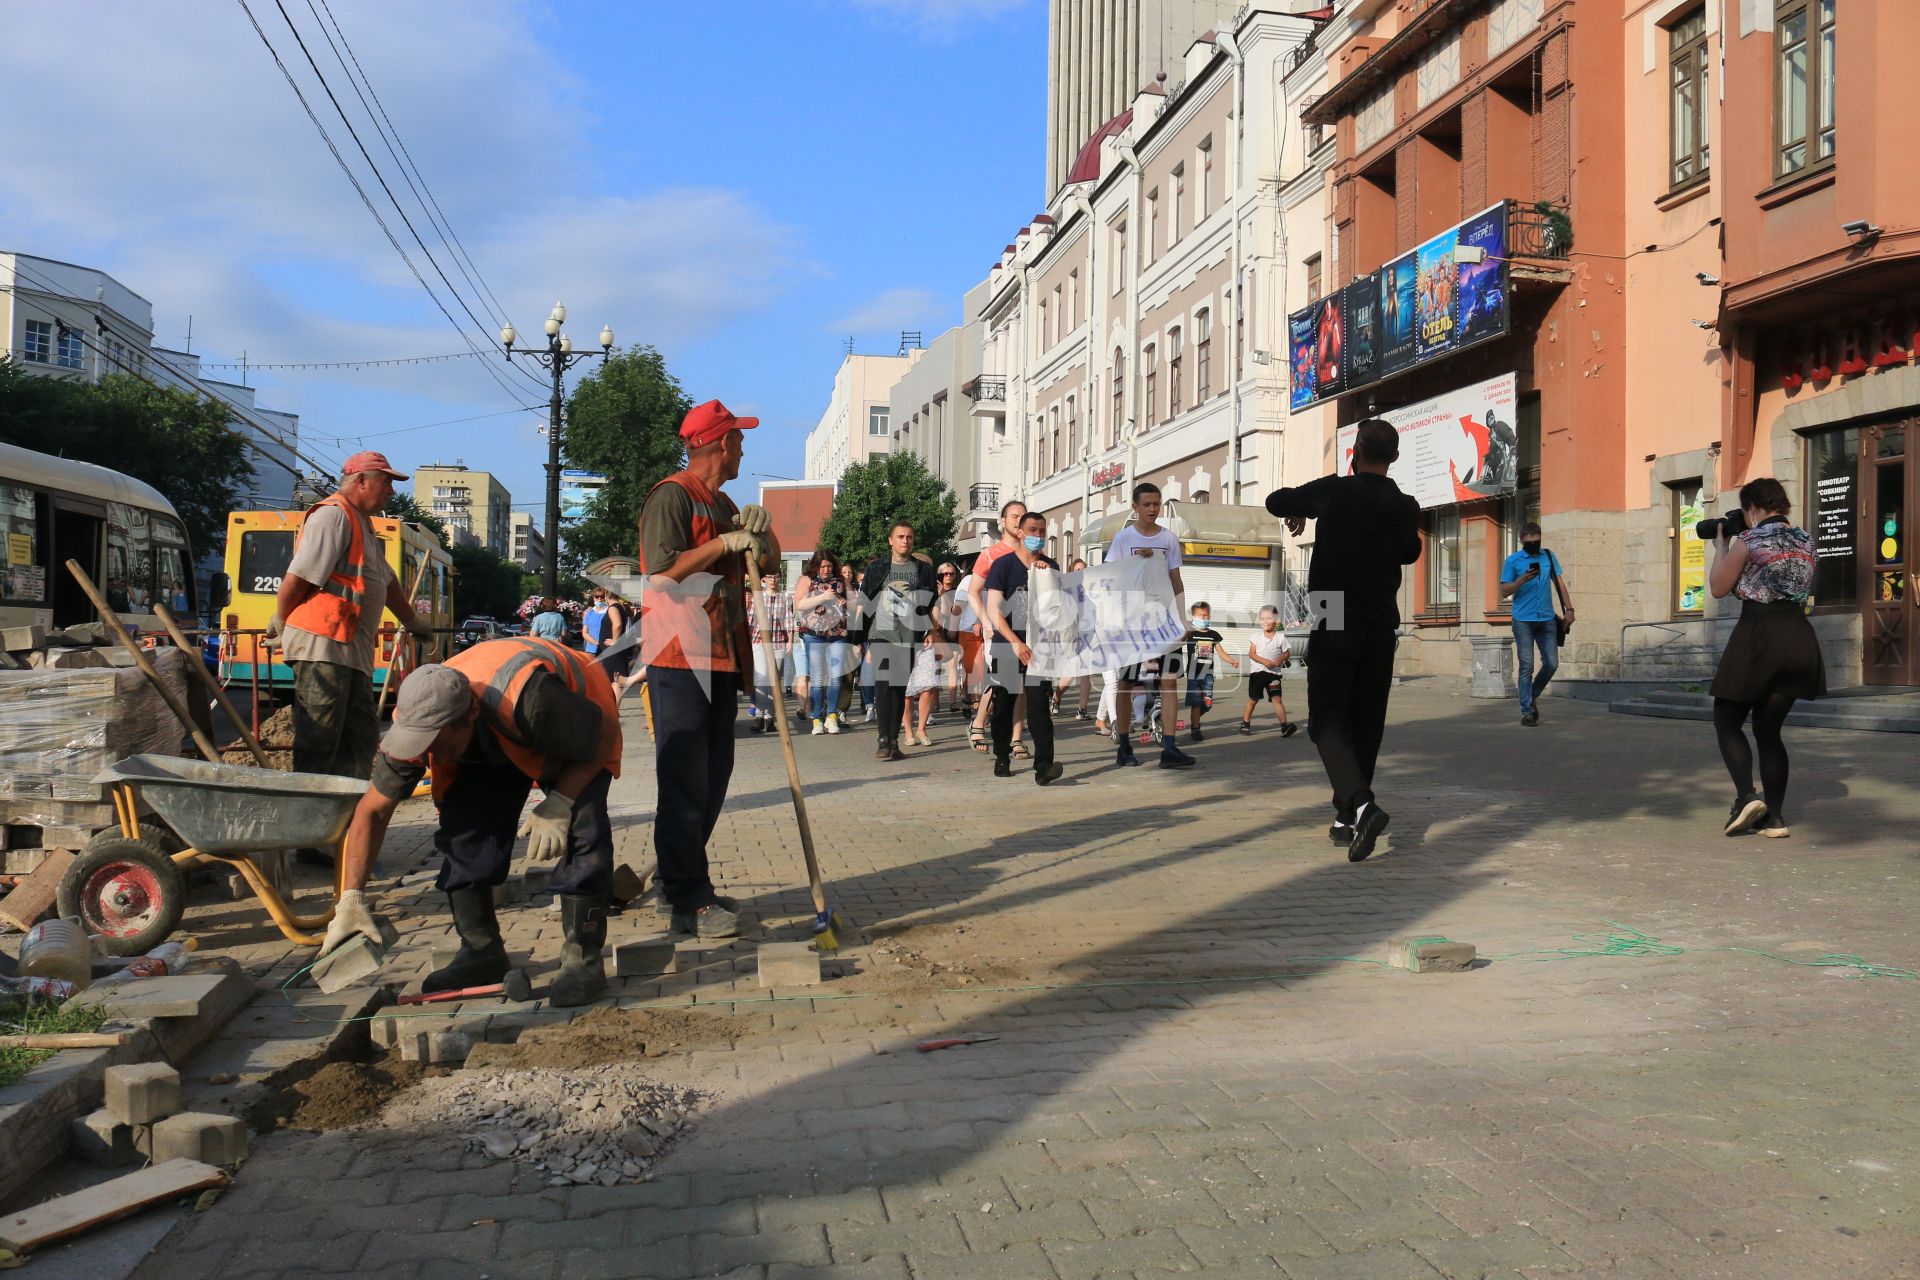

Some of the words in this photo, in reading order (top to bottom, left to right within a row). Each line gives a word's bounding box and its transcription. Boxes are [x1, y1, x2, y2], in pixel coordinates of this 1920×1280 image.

[1469, 224, 1493, 245] ВПЕРЁД
[1423, 316, 1453, 340] ОТЕЛЬ
[1818, 476, 1850, 487] КИНОТЕАТР
